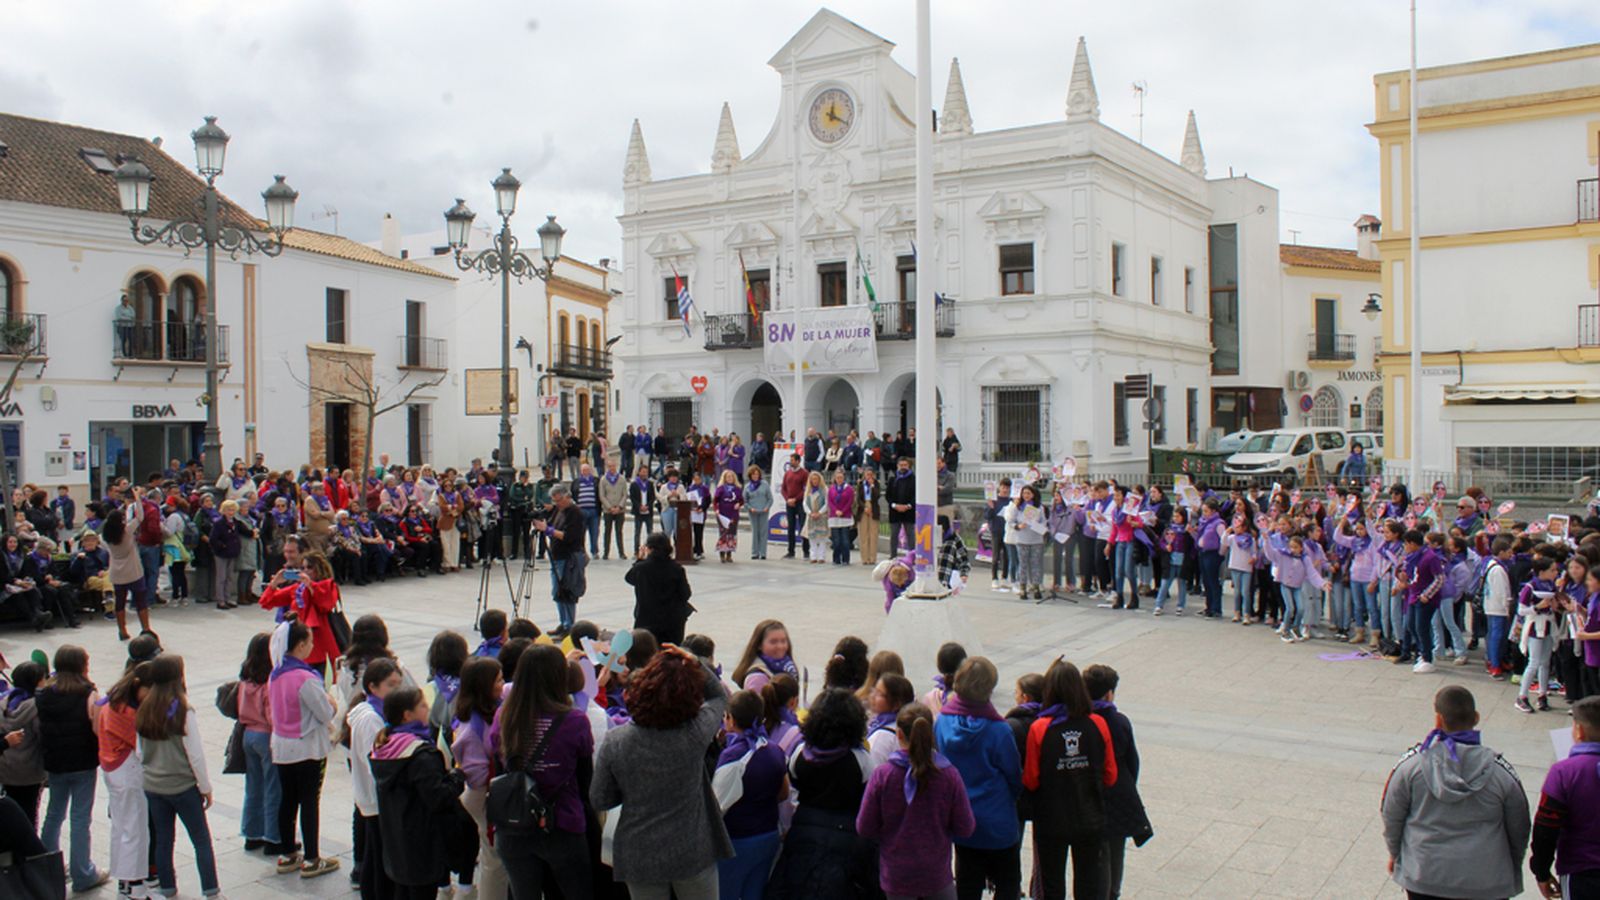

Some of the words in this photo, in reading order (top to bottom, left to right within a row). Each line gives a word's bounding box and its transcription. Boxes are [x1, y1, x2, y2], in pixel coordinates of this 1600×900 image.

[802, 331, 815, 342] DE
[818, 329, 832, 340] LA
[834, 327, 871, 340] MUJER
[1337, 371, 1382, 381] JAMONES
[132, 403, 177, 419] BBVA
